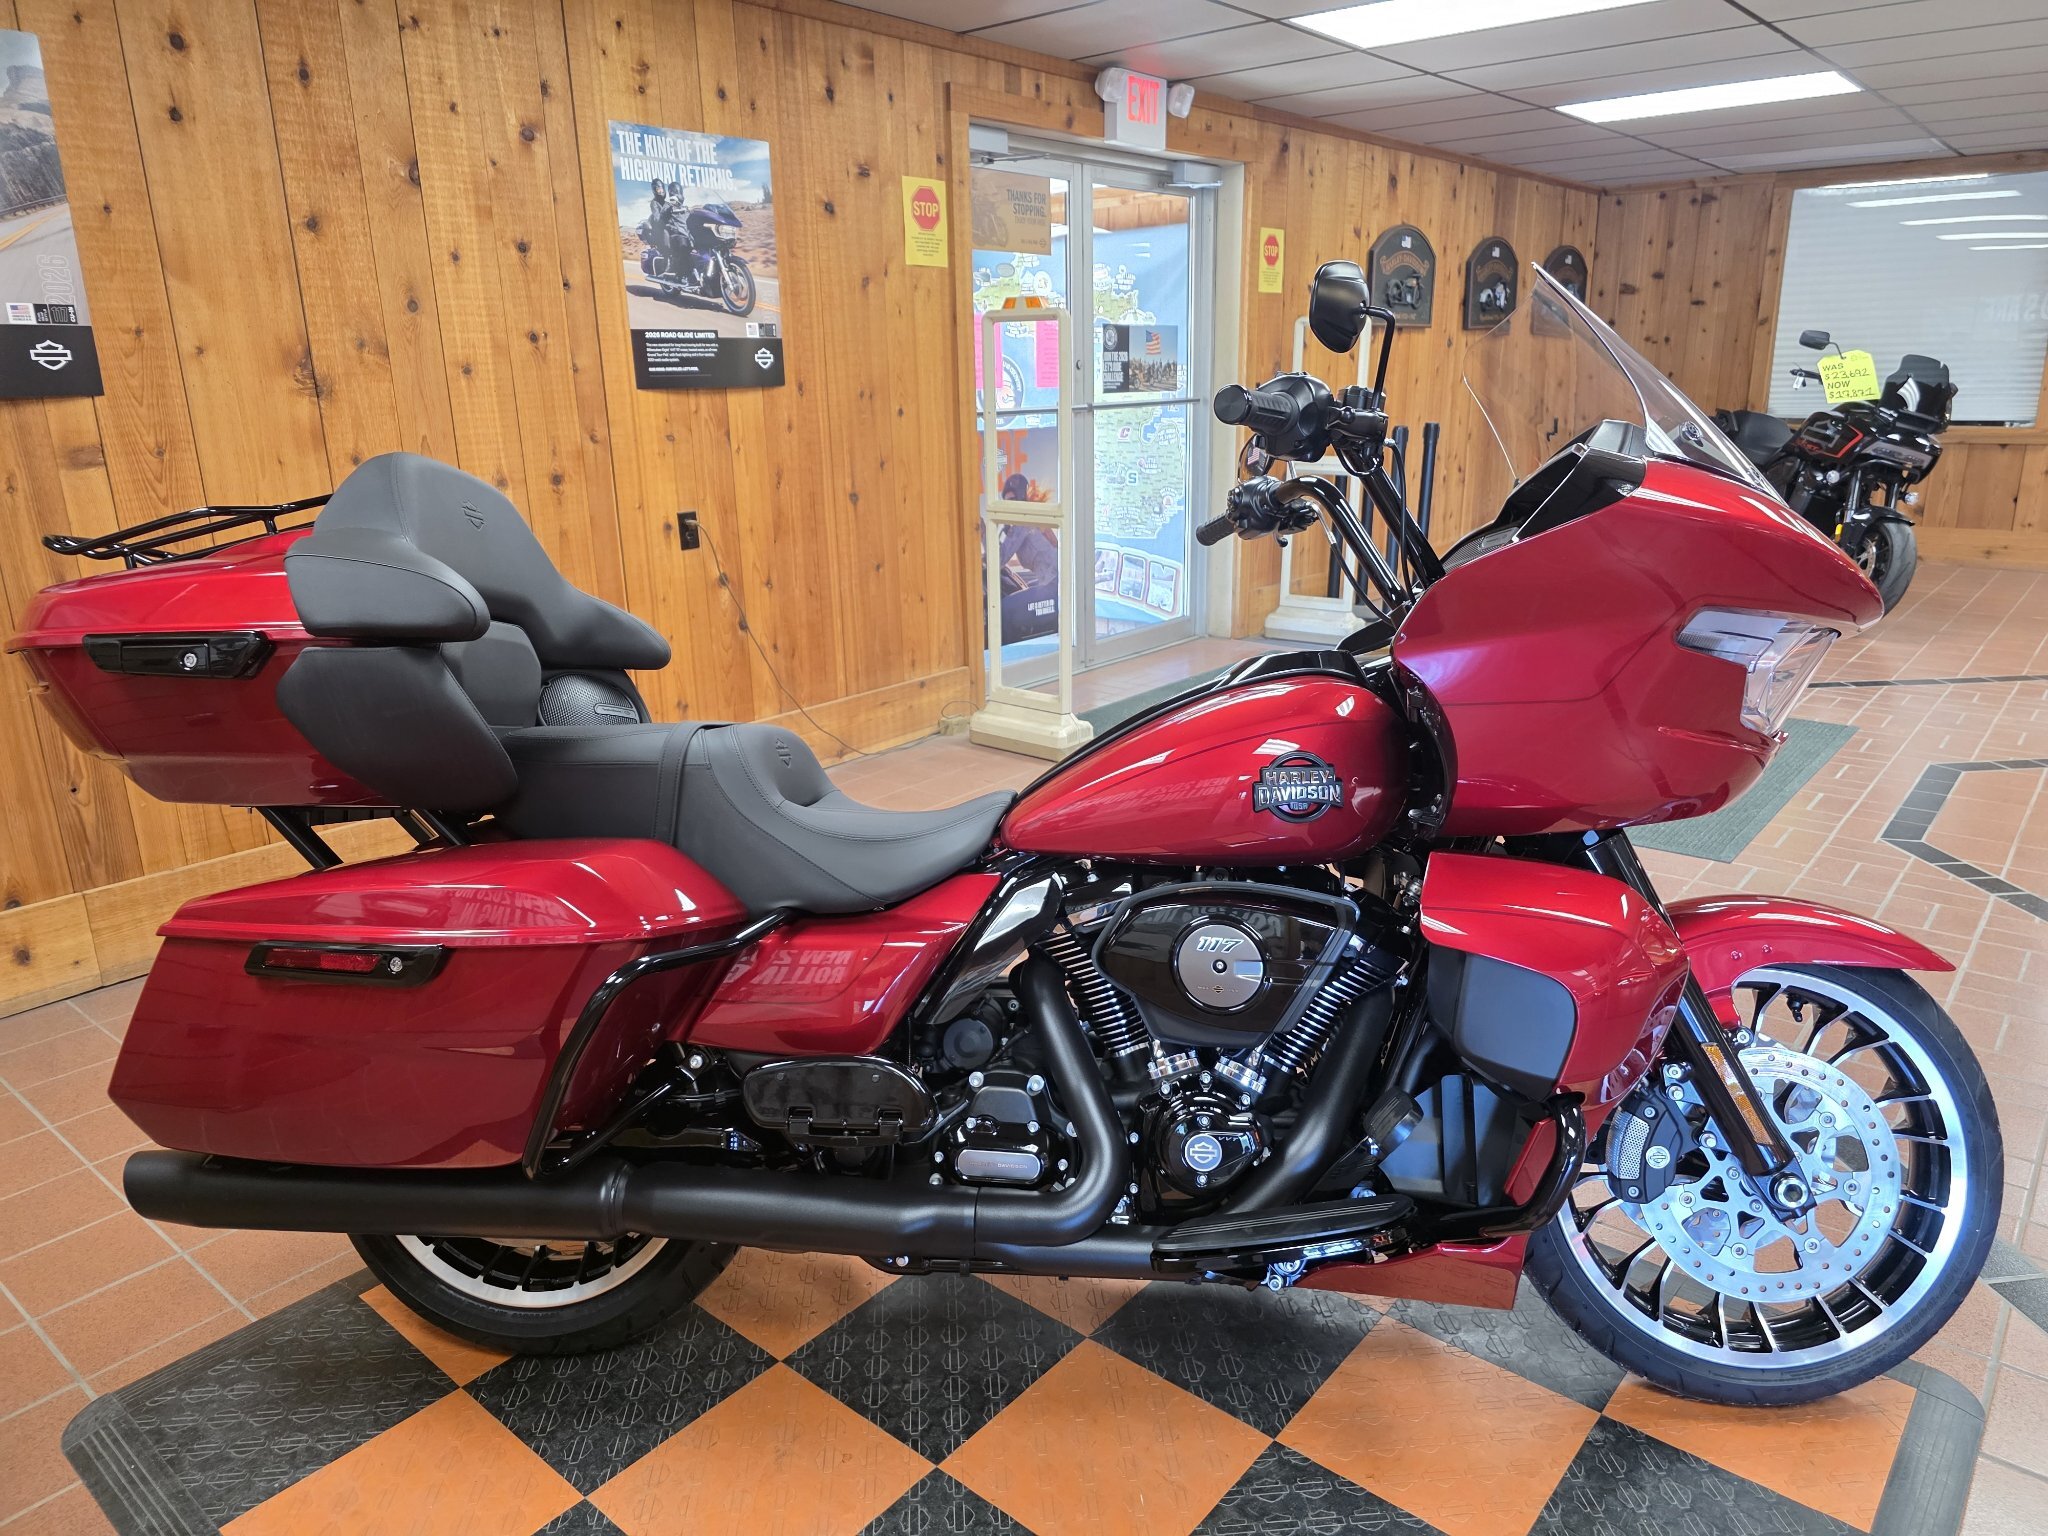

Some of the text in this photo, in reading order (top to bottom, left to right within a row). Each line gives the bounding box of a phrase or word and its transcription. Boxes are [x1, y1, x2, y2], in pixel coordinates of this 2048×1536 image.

[1127, 75, 1159, 125] EXIT
[616, 130, 718, 165] THE KING OF THE
[620, 157, 676, 185] HIGHWAY
[1006, 189, 1046, 205] THANKS FOR
[913, 200, 939, 218] STOP
[1264, 245, 1278, 257] STOP
[1822, 362, 1844, 371] WAS
[1827, 380, 1850, 389] NOW
[1265, 770, 1333, 785] HARLEY-
[1258, 785, 1341, 806] DAVIDSON
[1197, 936, 1244, 953] 117
